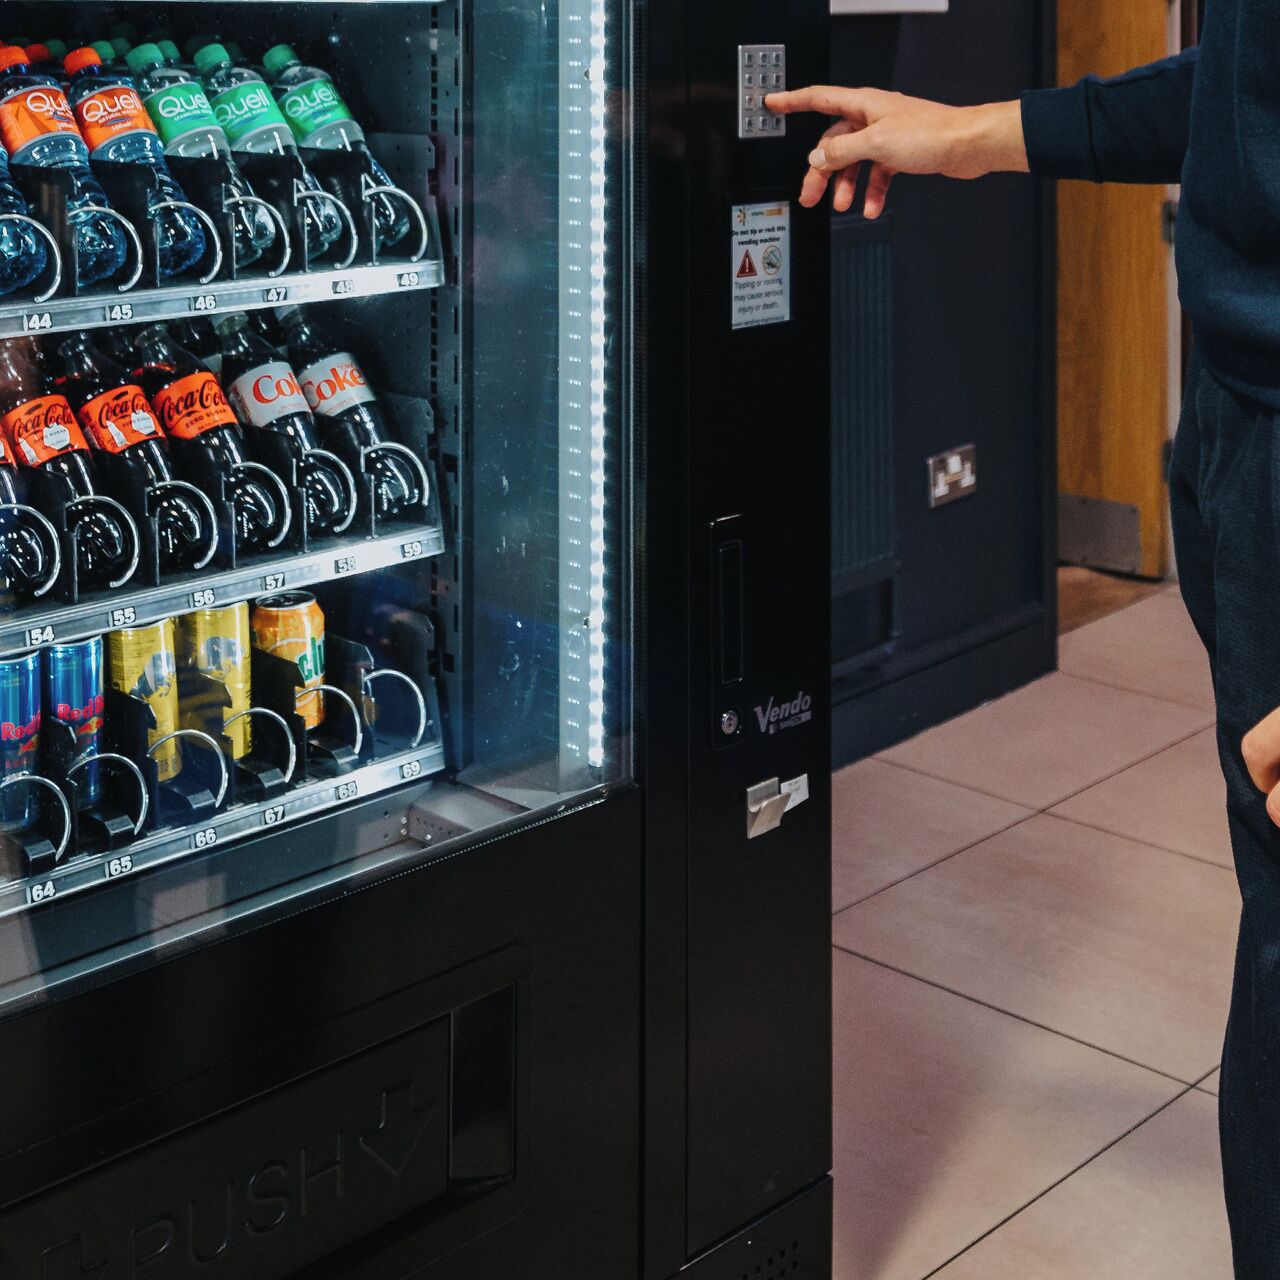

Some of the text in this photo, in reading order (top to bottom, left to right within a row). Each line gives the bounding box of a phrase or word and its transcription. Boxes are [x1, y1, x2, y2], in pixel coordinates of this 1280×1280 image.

[82, 91, 143, 123] Quell
[215, 88, 271, 124] Quell
[738, 238, 758, 246] vending
[400, 273, 420, 287] 49
[735, 281, 755, 289] Tipping
[266, 288, 288, 302] 47
[764, 289, 784, 298] serious
[195, 296, 217, 310] 46
[28, 312, 53, 329] 44
[110, 304, 133, 320] 45
[404, 543, 422, 558] 59
[264, 574, 285, 590] 57
[193, 590, 215, 607] 56
[112, 608, 136, 625] 55
[30, 626, 55, 643] 54
[57, 699, 95, 721] Red
[753, 690, 812, 733] Vendo
[402, 760, 422, 779] 69
[264, 806, 286, 824] 67
[194, 830, 217, 848] 66
[109, 856, 133, 876] 65
[30, 882, 56, 902] 64
[129, 1131, 346, 1280] PUSH
